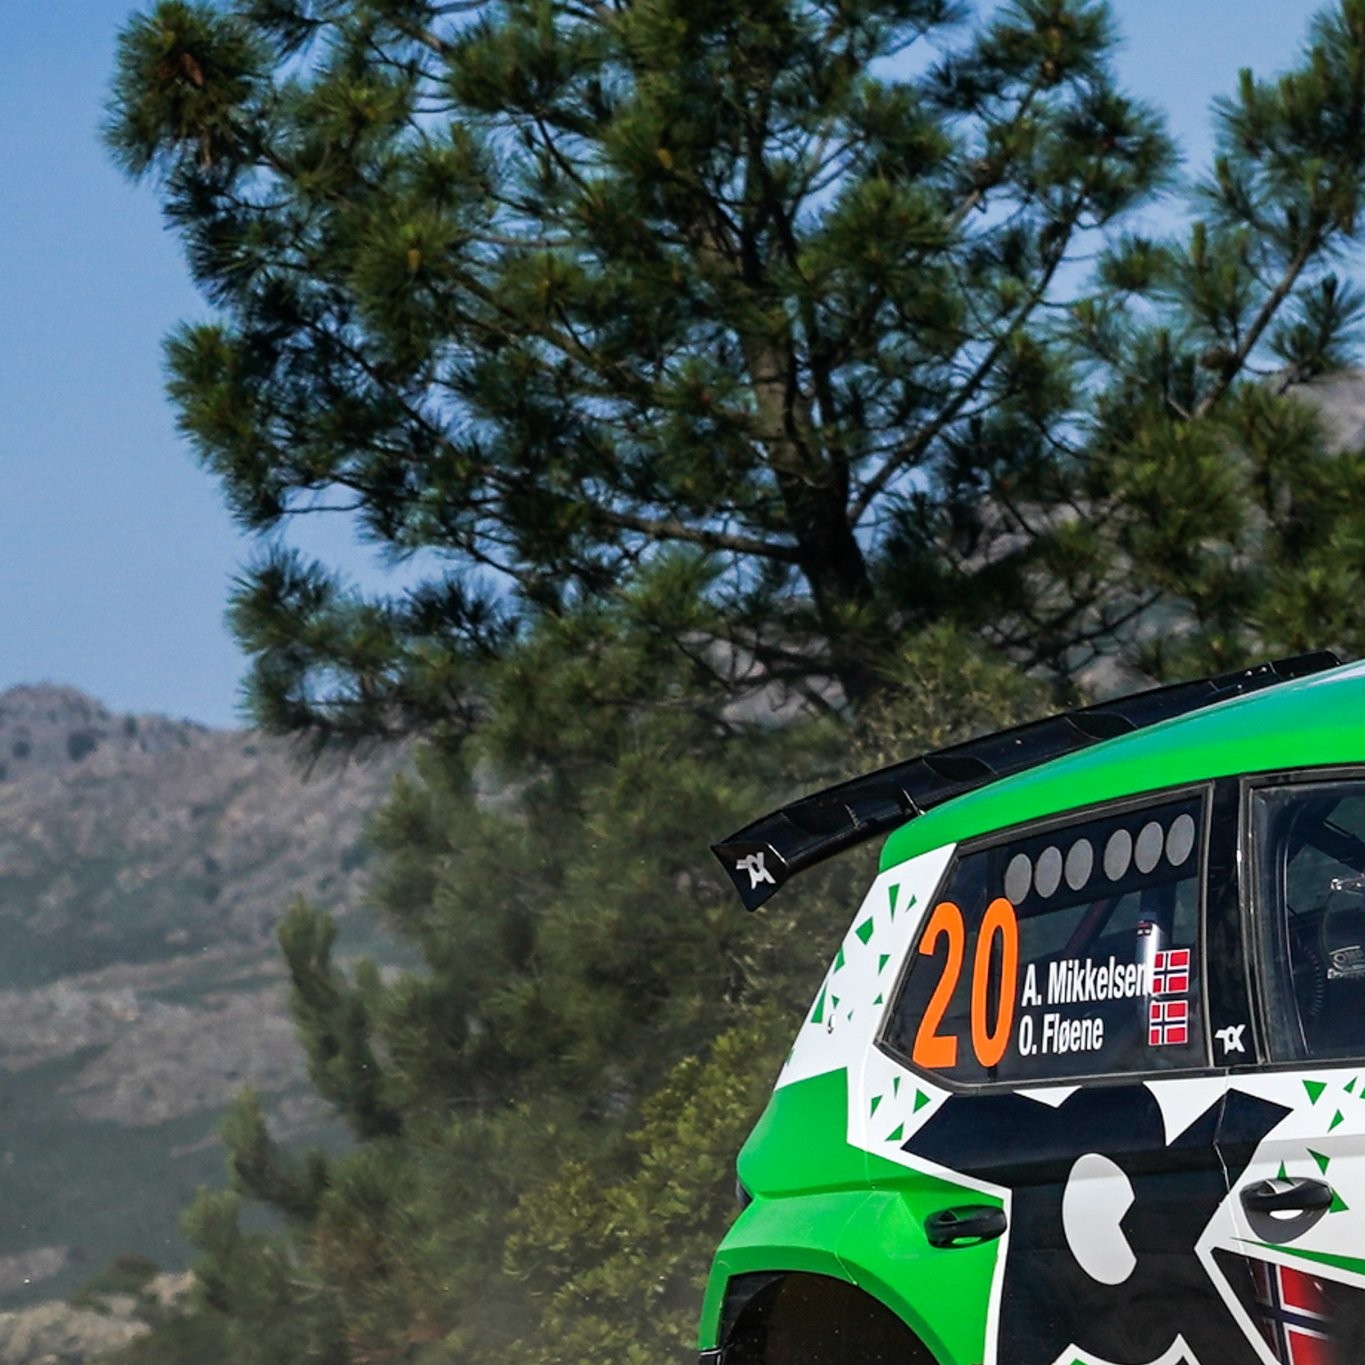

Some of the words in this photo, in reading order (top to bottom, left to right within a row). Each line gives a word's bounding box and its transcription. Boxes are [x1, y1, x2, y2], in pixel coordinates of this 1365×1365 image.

[911, 897, 1019, 1068] 20
[1021, 963, 1042, 1008] A.
[1047, 955, 1151, 1005] Mikkelsen
[1018, 1016, 1037, 1056] O.
[1042, 1012, 1104, 1055] Fløene
